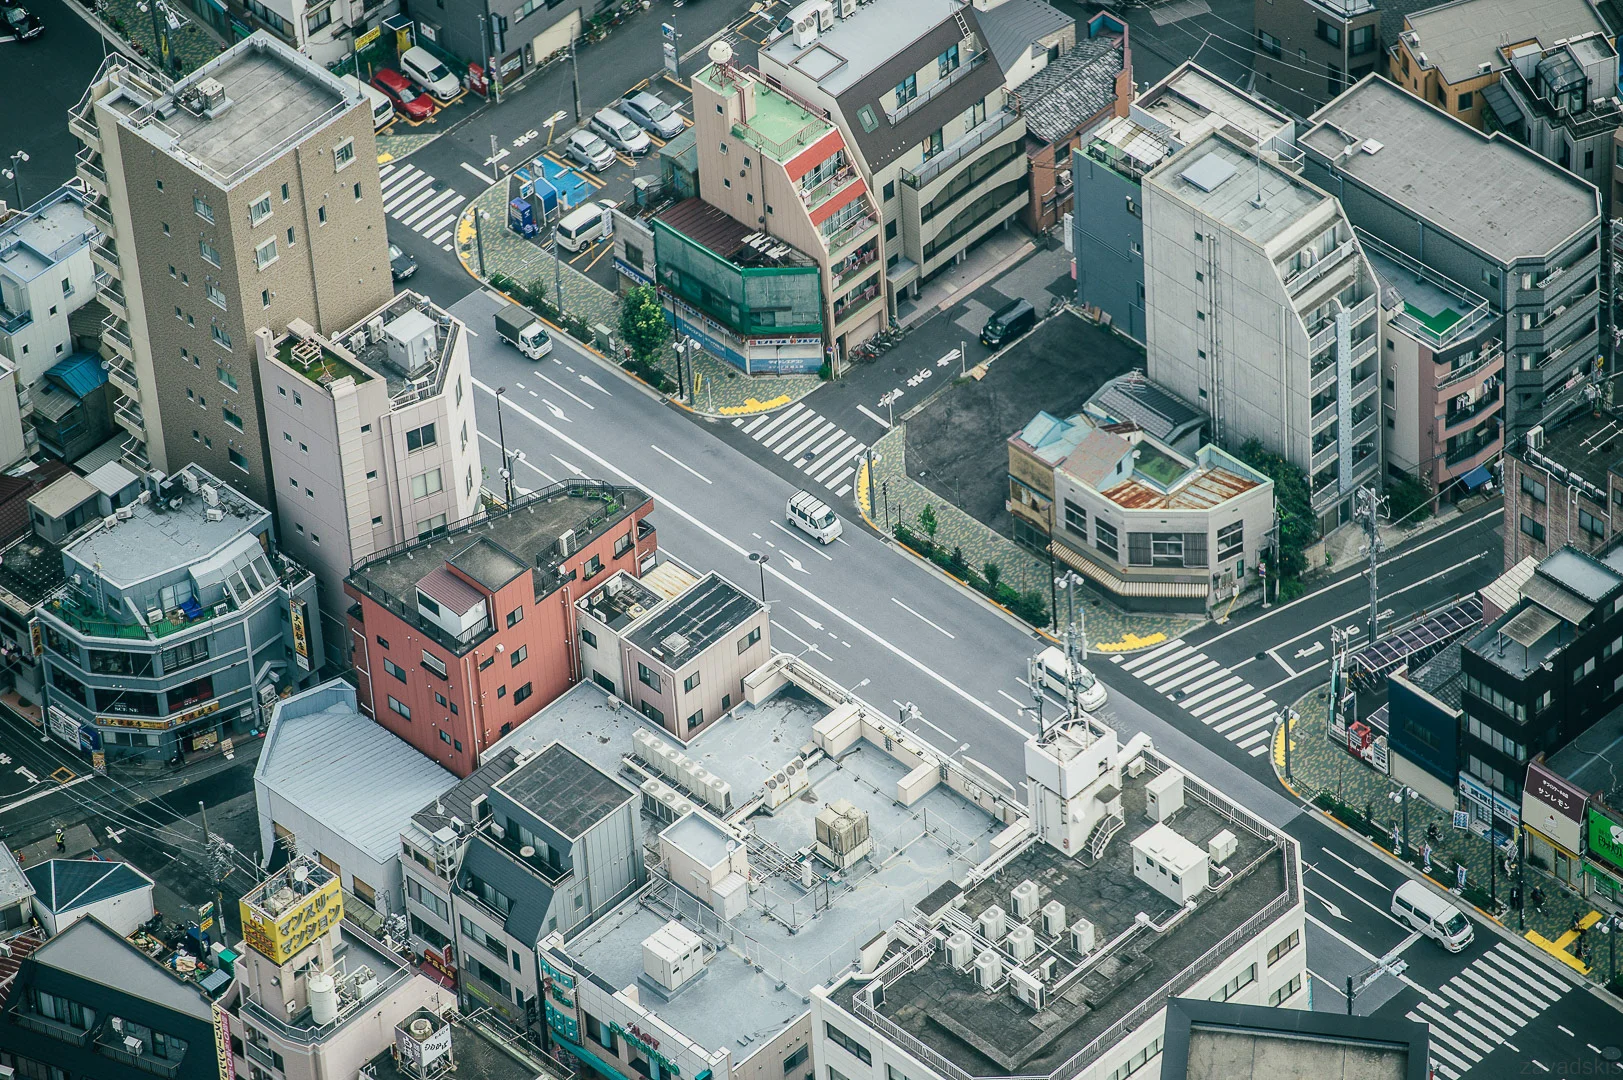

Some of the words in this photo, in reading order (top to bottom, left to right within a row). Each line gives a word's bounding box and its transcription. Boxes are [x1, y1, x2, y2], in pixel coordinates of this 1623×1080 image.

[1538, 787, 1570, 810] サンレモン
[279, 889, 339, 936] マンスリー
[281, 904, 341, 954] マンション
